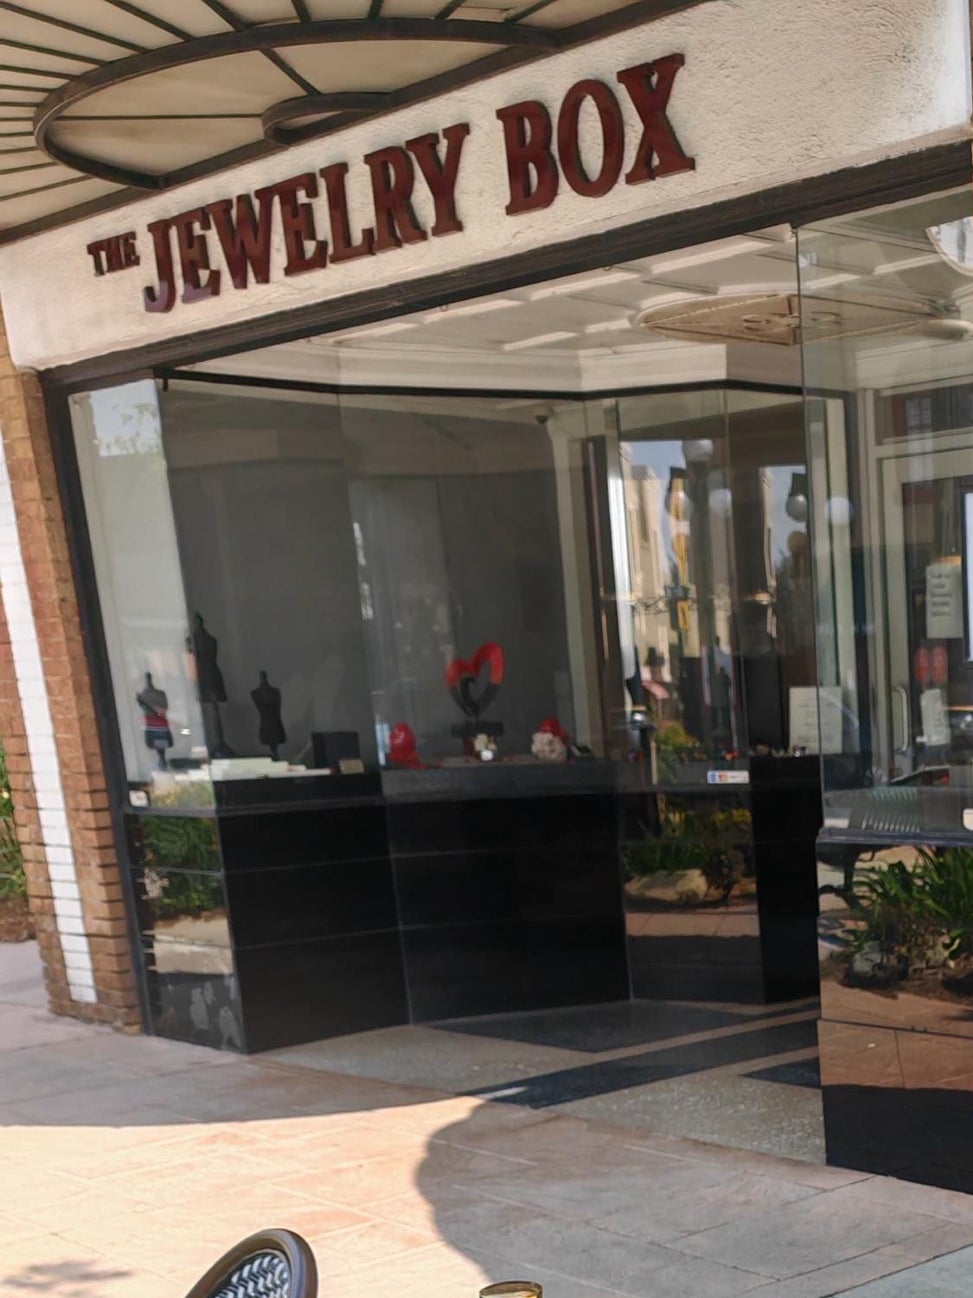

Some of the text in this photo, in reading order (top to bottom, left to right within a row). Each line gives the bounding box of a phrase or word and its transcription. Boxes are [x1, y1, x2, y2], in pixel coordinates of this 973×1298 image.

[87, 53, 696, 313] THE JEWELRY BOX
